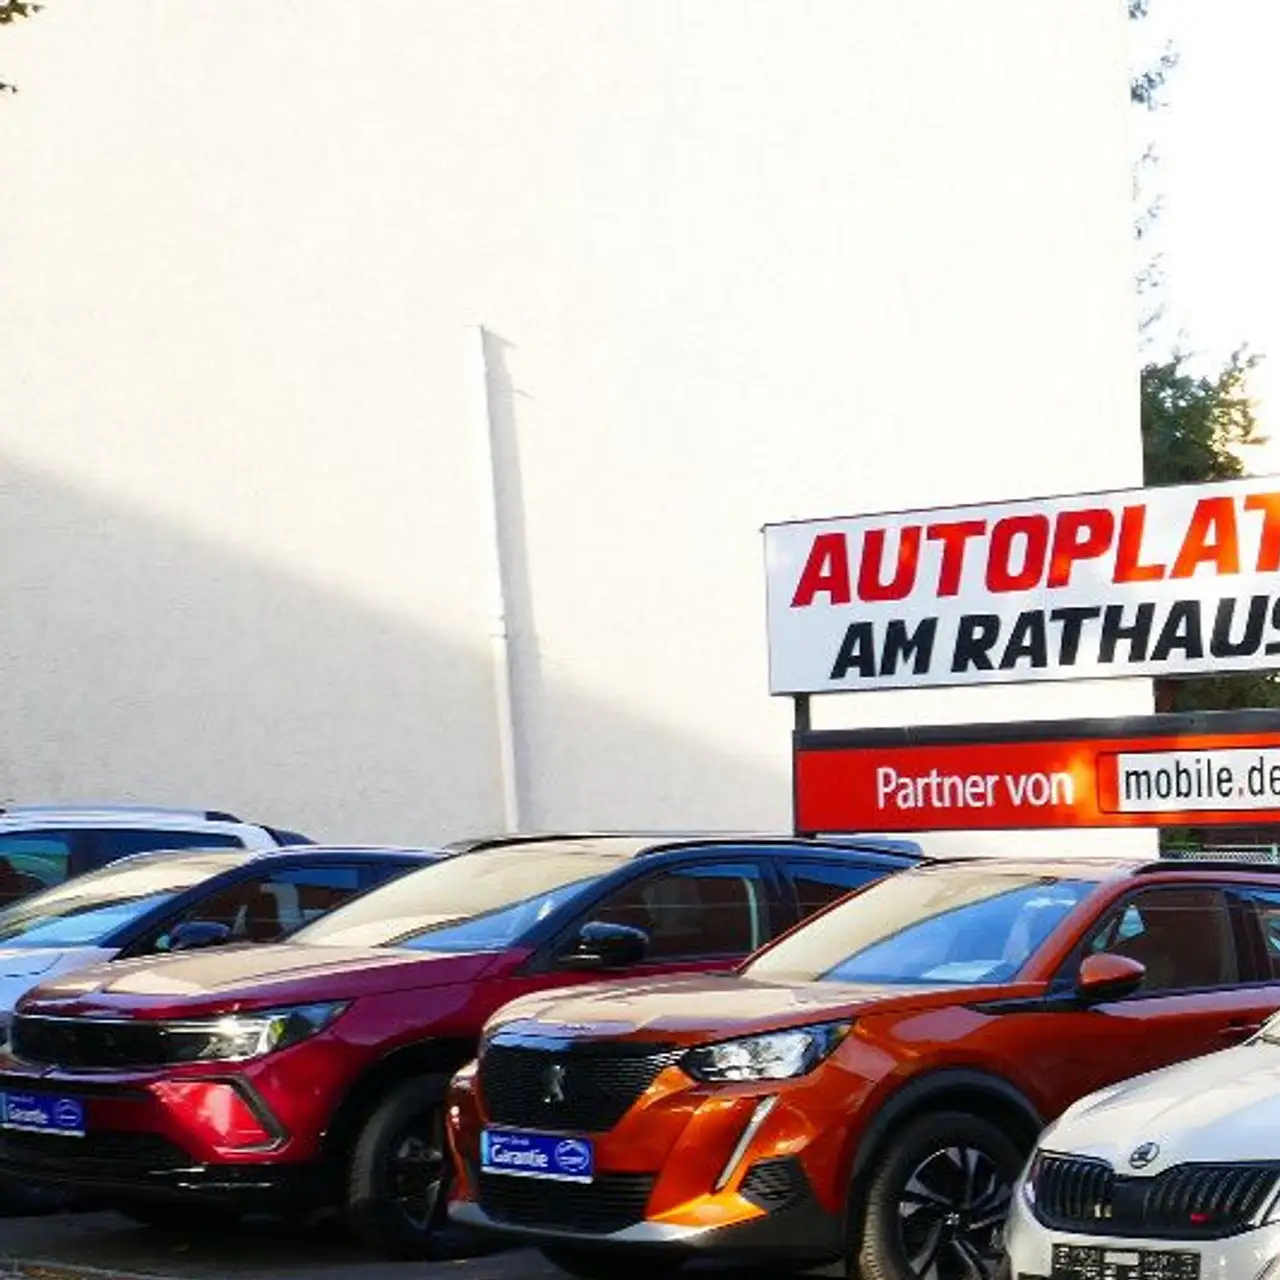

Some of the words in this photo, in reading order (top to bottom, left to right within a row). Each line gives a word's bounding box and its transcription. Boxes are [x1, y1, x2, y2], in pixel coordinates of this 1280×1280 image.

[829, 616, 938, 679] AM
[876, 766, 998, 808] Partner
[1005, 771, 1074, 806] von
[491, 1144, 549, 1168] Garantie
